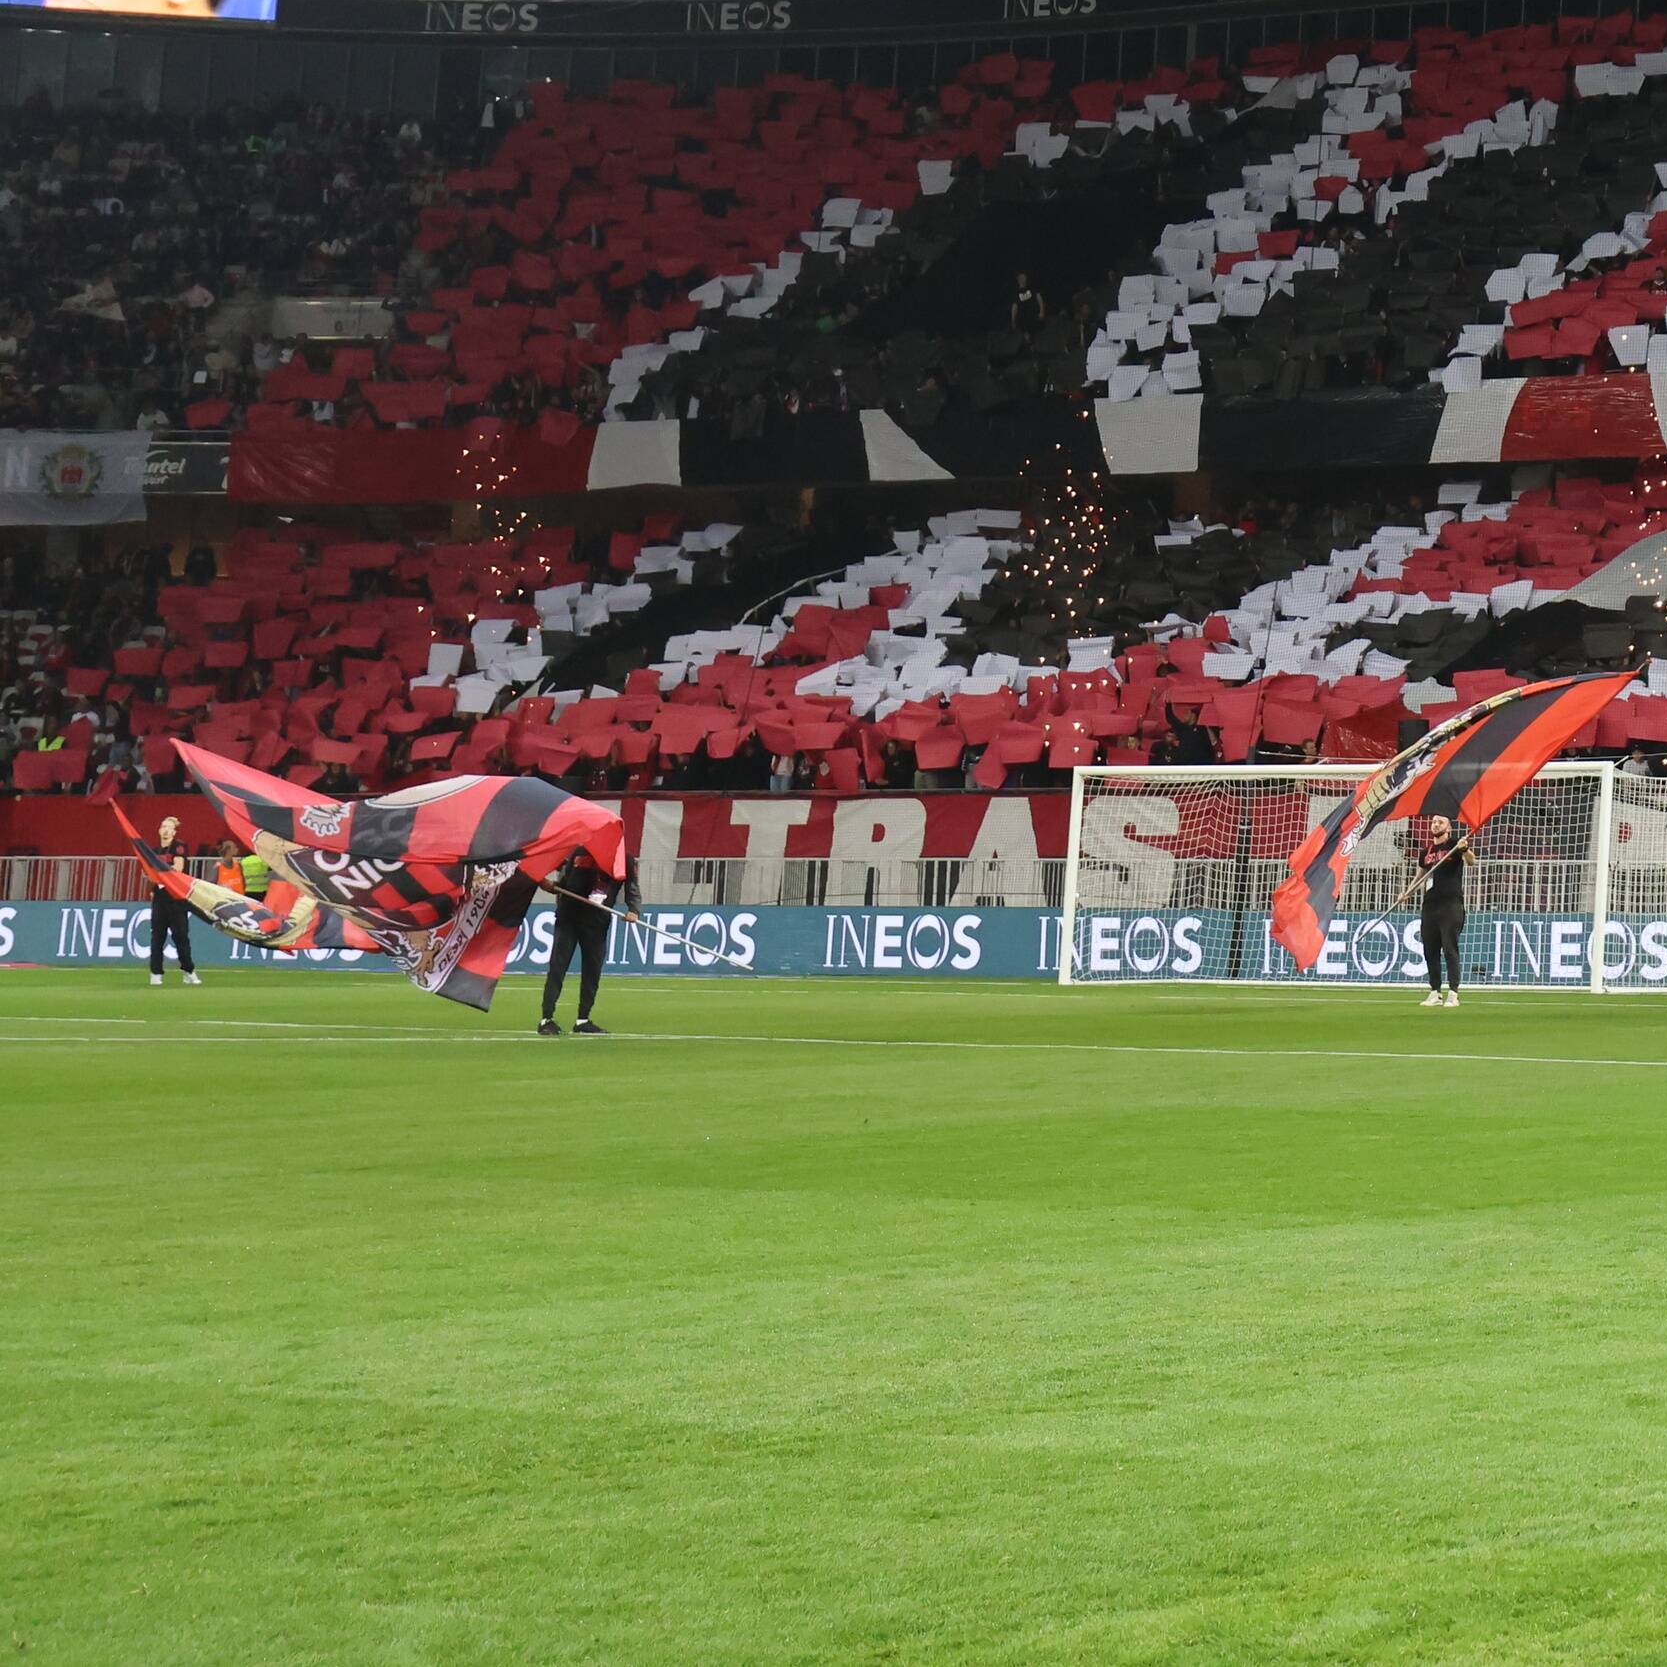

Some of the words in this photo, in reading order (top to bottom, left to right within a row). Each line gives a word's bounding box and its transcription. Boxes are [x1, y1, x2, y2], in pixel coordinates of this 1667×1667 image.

[424, 2, 539, 32] INEOS
[686, 1, 792, 31] INEOS
[607, 912, 758, 967] INEOS
[823, 914, 982, 970] INEOS
